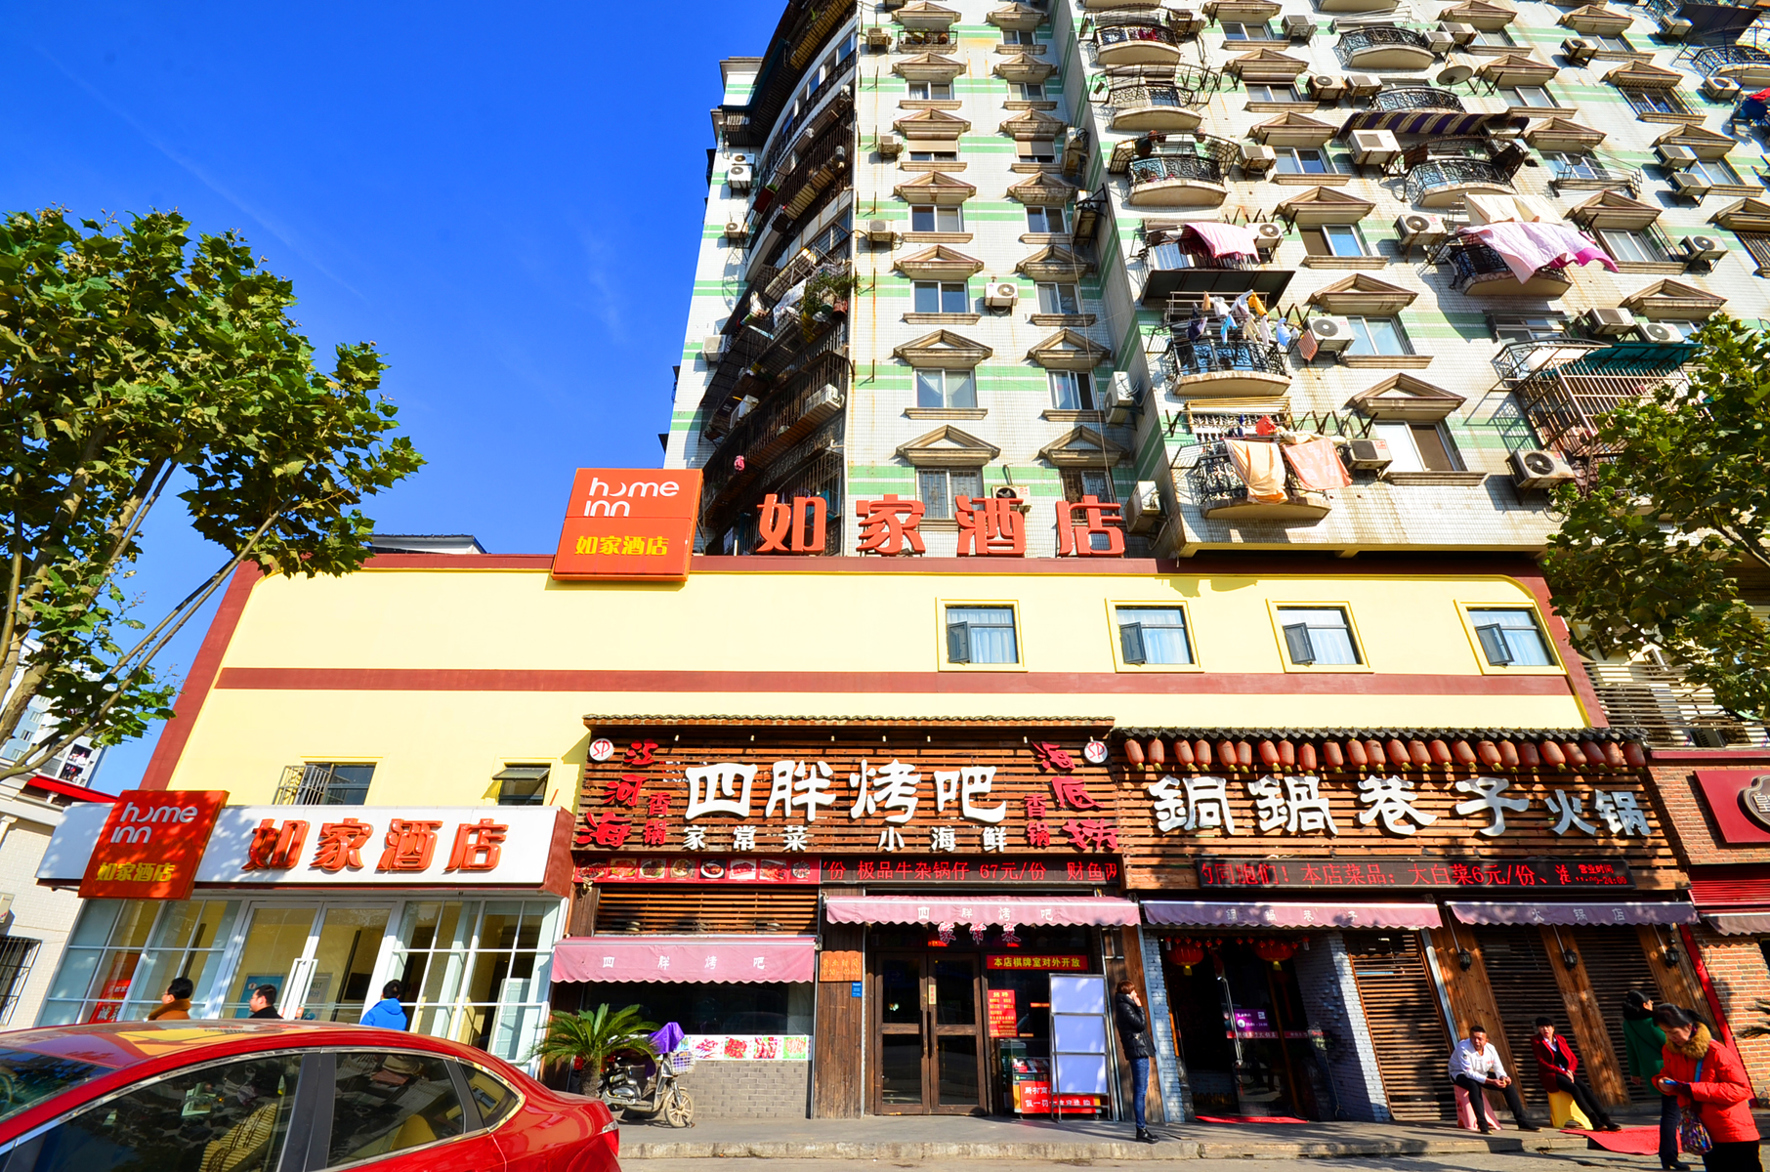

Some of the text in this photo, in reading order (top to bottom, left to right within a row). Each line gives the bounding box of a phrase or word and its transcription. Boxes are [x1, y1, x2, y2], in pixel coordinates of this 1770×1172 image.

[588, 477, 680, 497] home
[583, 500, 631, 517] inn
[755, 493, 1126, 557] 如家酒店
[574, 535, 669, 556] 如家酒店
[684, 758, 1007, 824] 四胖烤吧
[120, 802, 199, 823] home
[1024, 793, 1051, 847] 香锅
[110, 826, 152, 843] inn
[240, 817, 510, 872] 如家酒店
[683, 825, 1009, 853] 家常菜 小海鲜
[96, 861, 176, 882] 如家酒店
[857, 860, 970, 880] 极品牛杂锅仔
[979, 861, 1047, 881] 67元/份
[917, 906, 1054, 923] 四胖烤吧
[602, 955, 766, 971] 四胖烤吧
[993, 956, 1082, 968] 本店棋牌室对外开放
